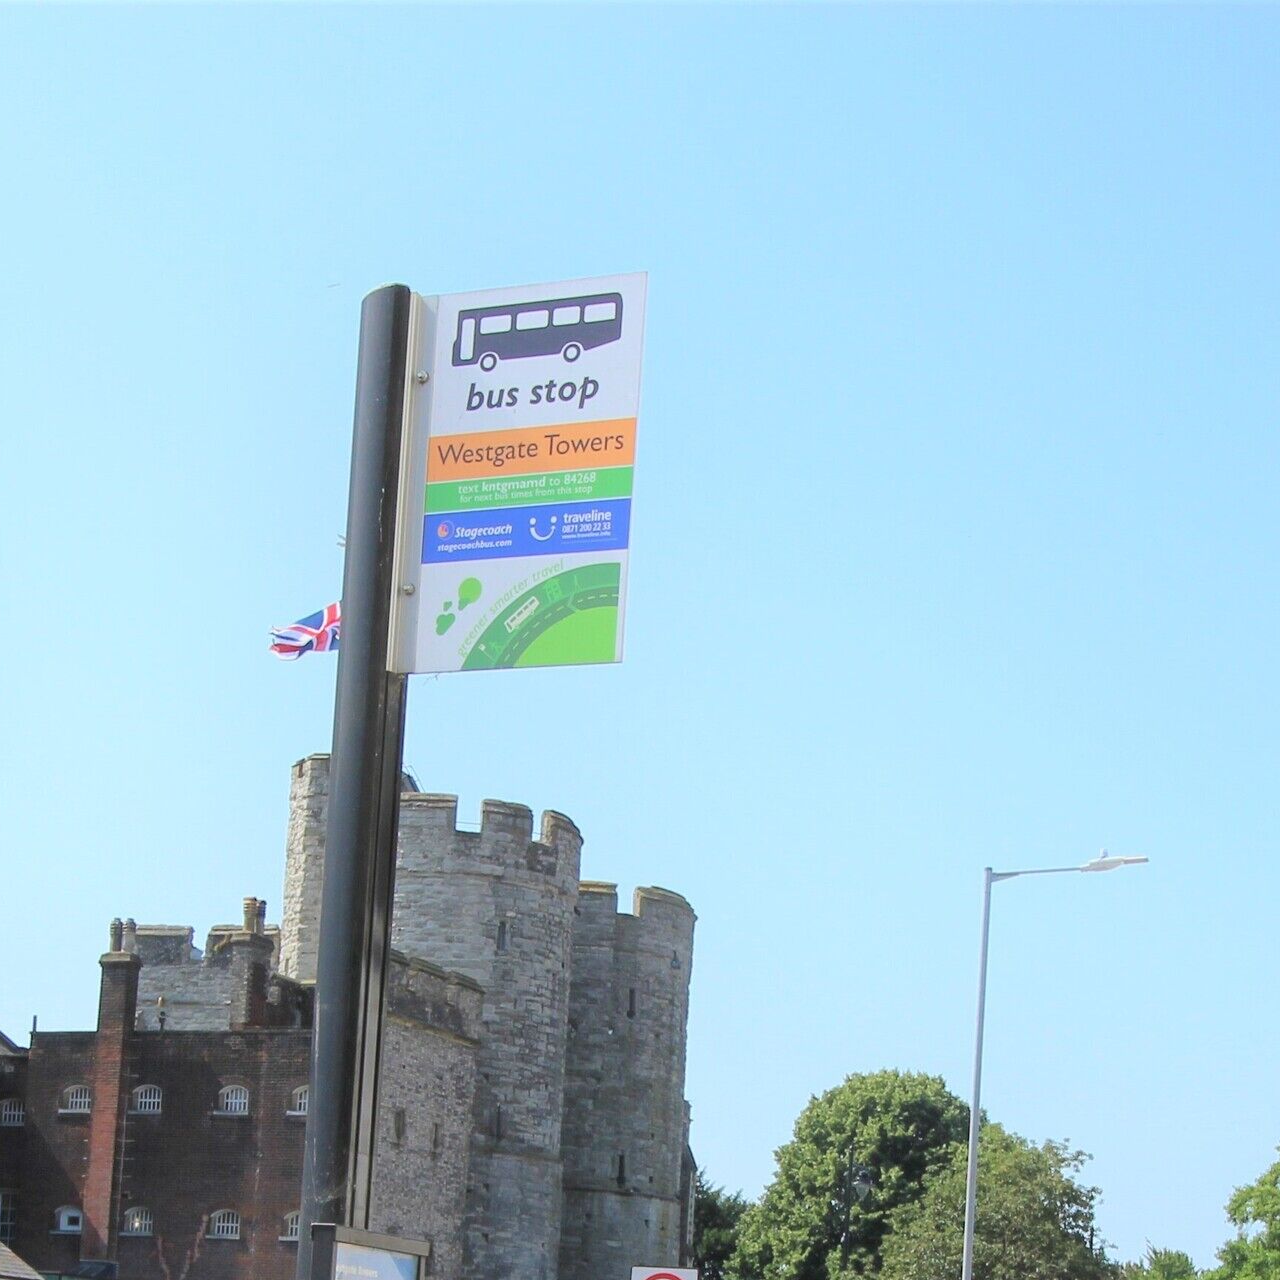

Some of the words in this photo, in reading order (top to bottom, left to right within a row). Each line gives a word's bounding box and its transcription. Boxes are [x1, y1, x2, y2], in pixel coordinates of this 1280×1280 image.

[466, 382, 519, 411] bus
[530, 376, 599, 409] stop
[437, 442, 538, 467] Westgate
[544, 434, 624, 456] Towers
[458, 484, 479, 494] text
[549, 477, 561, 487] to
[564, 472, 596, 485] 84268
[460, 494, 471, 503] for
[474, 493, 493, 502] next
[494, 490, 508, 500] bus
[511, 489, 533, 499] times
[535, 487, 556, 497] from
[574, 485, 593, 496] stop
[563, 509, 612, 524] traveline
[454, 524, 512, 540] Stagecoach
[437, 539, 512, 553] stagecoachbus.com
[489, 578, 529, 615] smarter
[532, 558, 565, 580] travel
